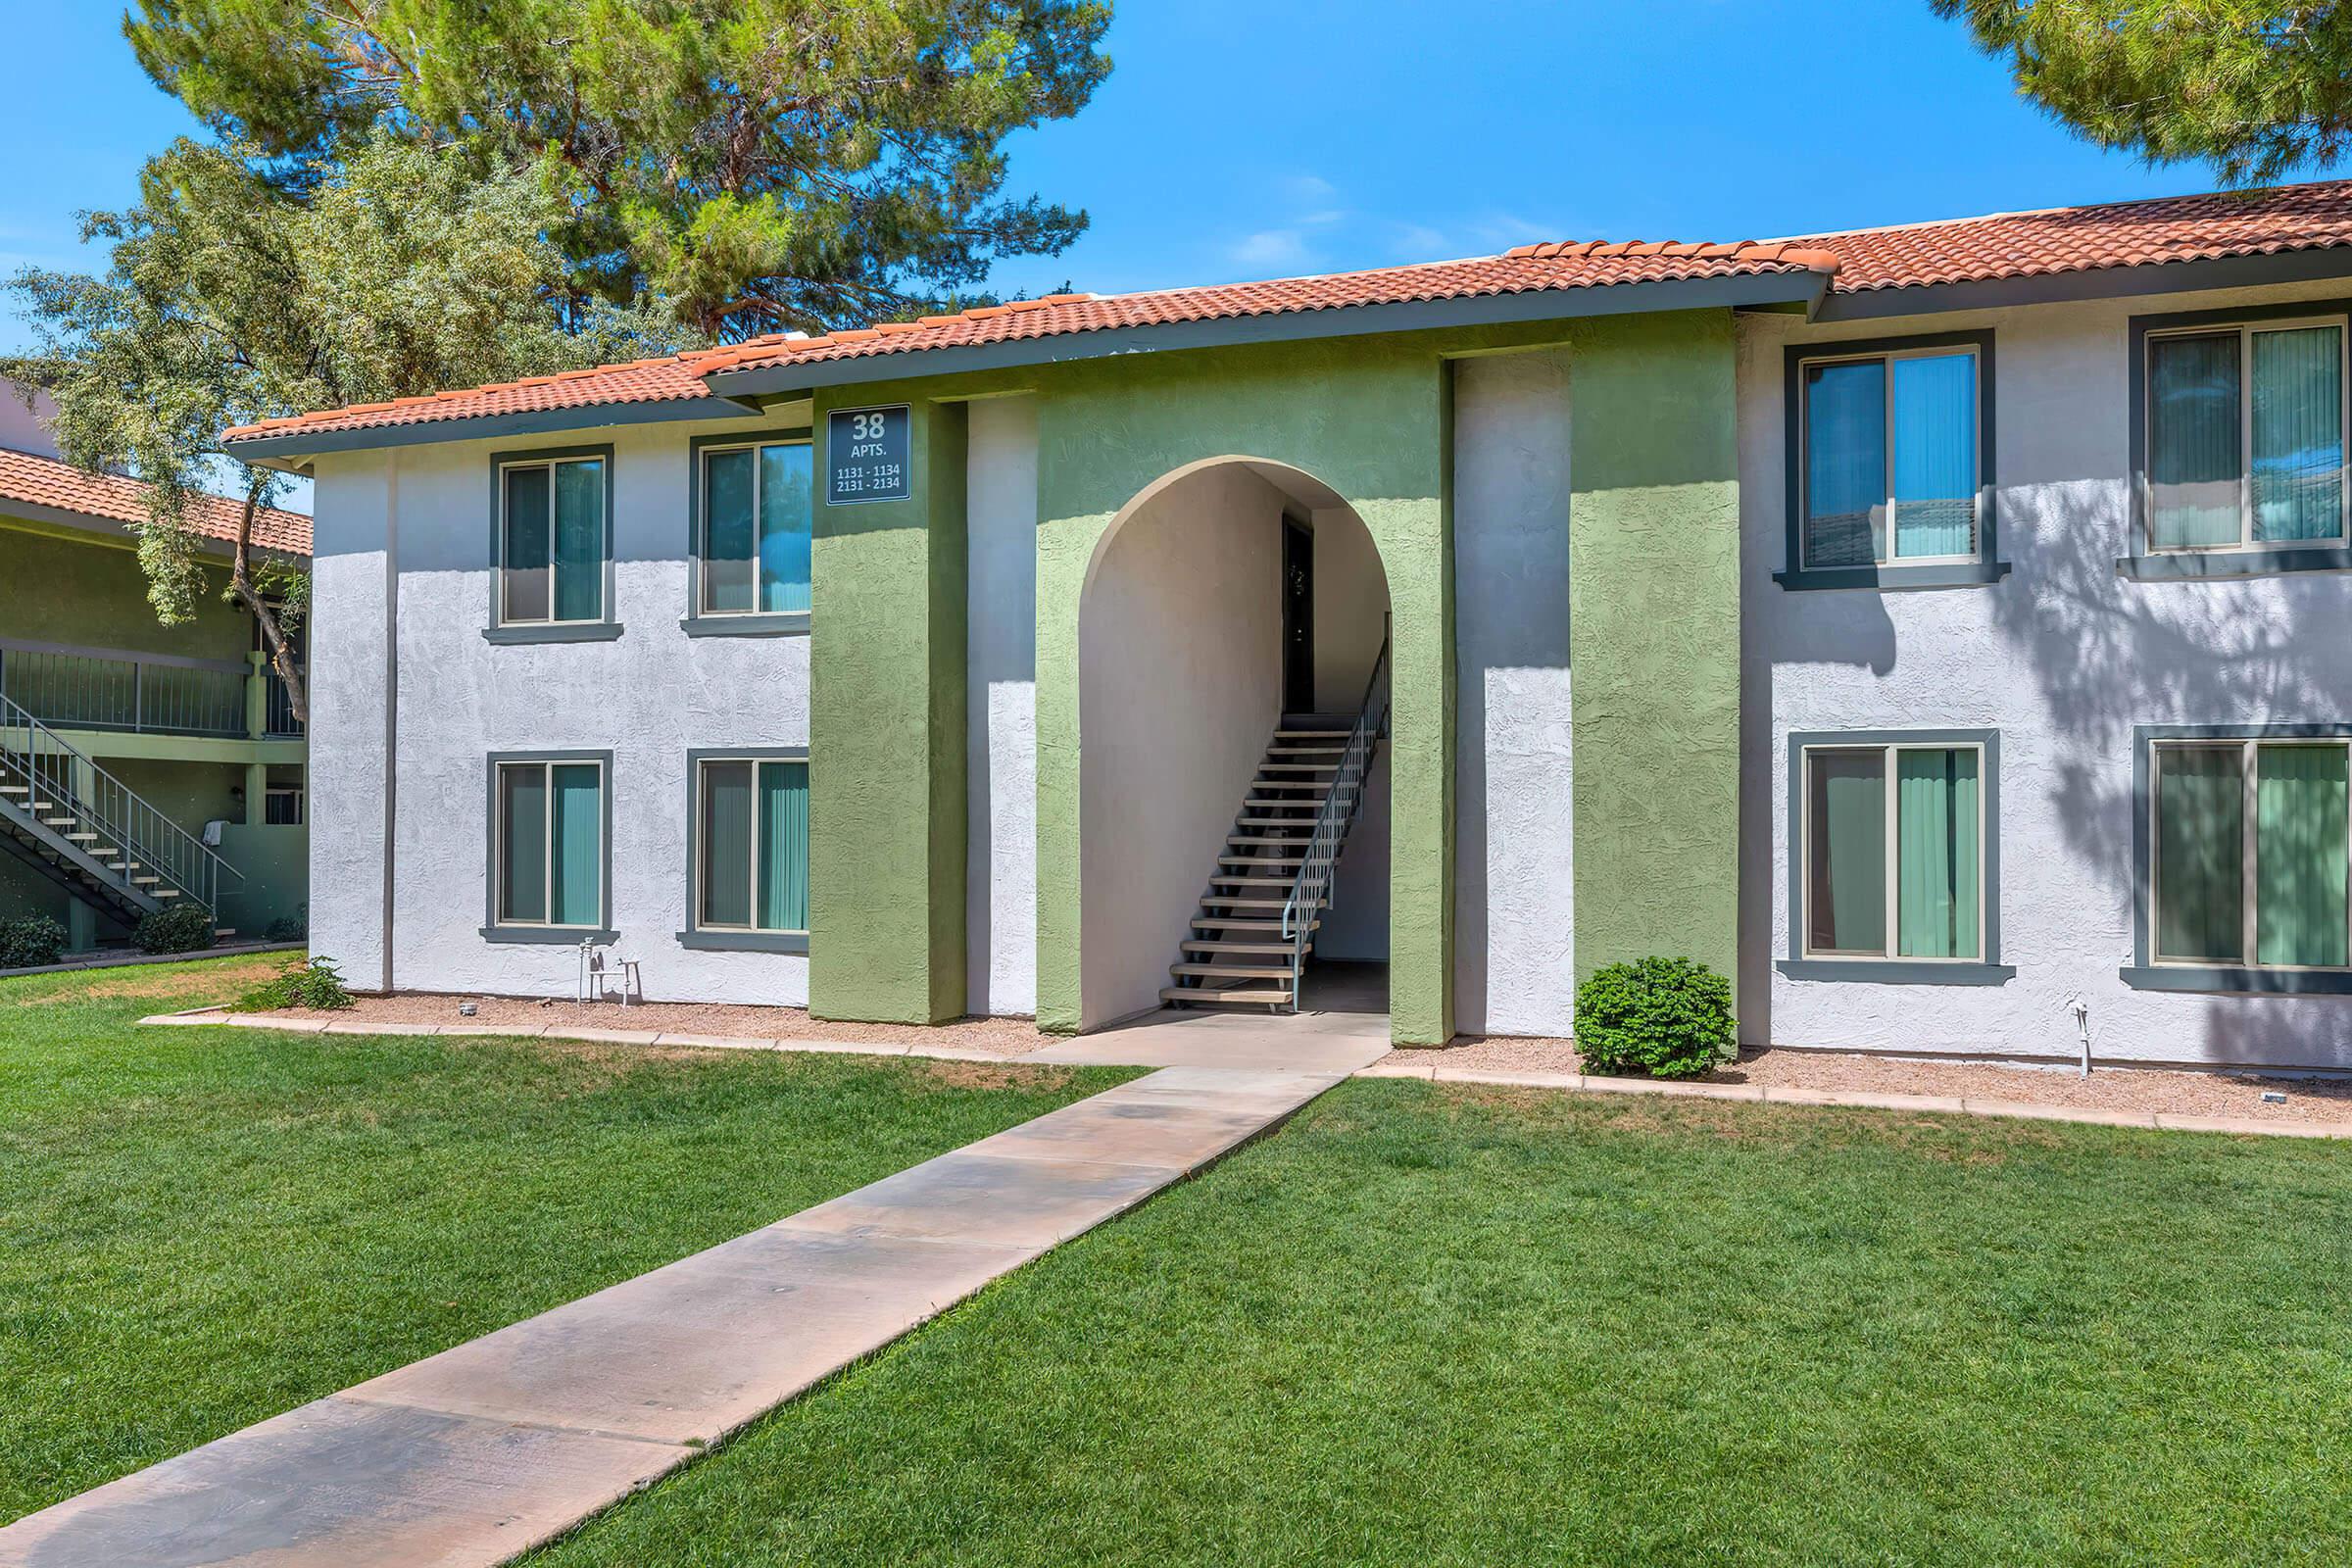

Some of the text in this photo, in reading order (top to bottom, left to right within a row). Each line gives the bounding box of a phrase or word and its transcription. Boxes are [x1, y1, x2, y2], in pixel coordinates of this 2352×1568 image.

[853, 413, 885, 440] 38
[851, 443, 887, 458] APTS.
[837, 467, 863, 479] 1131
[874, 464, 900, 477] 1134
[837, 480, 863, 492] 2131
[873, 477, 900, 490] 2134
